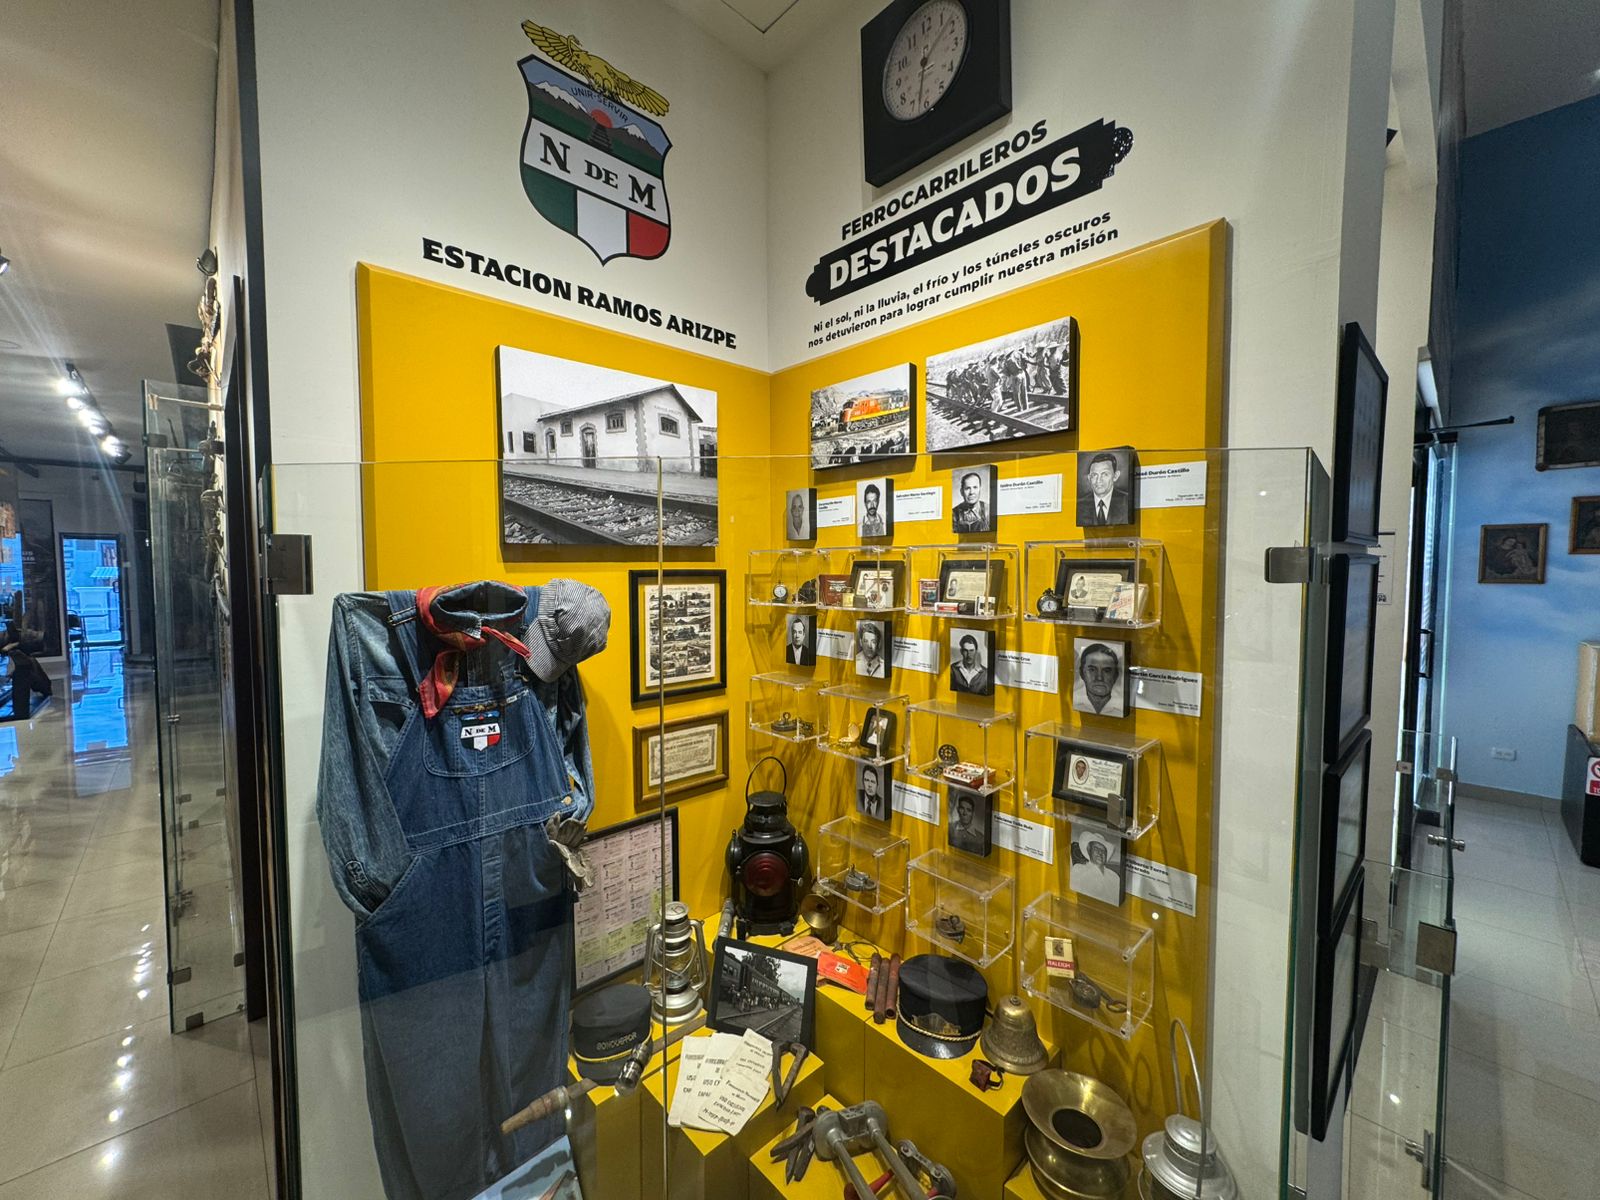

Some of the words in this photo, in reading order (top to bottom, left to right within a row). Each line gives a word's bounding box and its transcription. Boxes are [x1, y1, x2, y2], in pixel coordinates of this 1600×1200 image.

[921, 17, 932, 35] 12
[949, 20, 955, 35] 2
[908, 34, 916, 50] 11
[952, 37, 959, 52] 3
[898, 56, 909, 73] 10
[947, 60, 954, 73] 4
[896, 78, 902, 89] 9
[939, 80, 945, 95] 5
[900, 92, 906, 106] 8
[910, 100, 915, 112] 7
[923, 97, 930, 109] 6
[539, 132, 571, 174] N
[584, 159, 618, 189] DE
[629, 174, 656, 212] M
[841, 119, 1047, 241] FERROCARRILEROS
[829, 147, 1081, 290] DESTACADOS
[813, 321, 823, 333] Ni
[825, 318, 833, 328] el
[836, 312, 852, 325] sol,
[854, 306, 863, 318] ni
[866, 303, 875, 314] la
[878, 291, 910, 309] lluvia,
[913, 283, 923, 295] el
[926, 274, 949, 291] frío
[952, 271, 959, 282] y
[963, 262, 982, 277] los
[985, 238, 1040, 267] túneles
[1044, 211, 1111, 244] oscuros
[422, 237, 571, 302] ESTACION
[577, 285, 662, 327] RAMOS
[666, 315, 737, 350] ARIZPE
[808, 336, 824, 349] nos
[825, 317, 877, 342] detuvieron
[880, 308, 903, 325] para
[906, 293, 941, 313] lograr
[944, 272, 994, 300] cumplir
[998, 252, 1055, 280] nuestra
[1060, 228, 1119, 258] misión
[488, 725, 496, 733] M
[1047, 960, 1071, 968] RALEIGH
